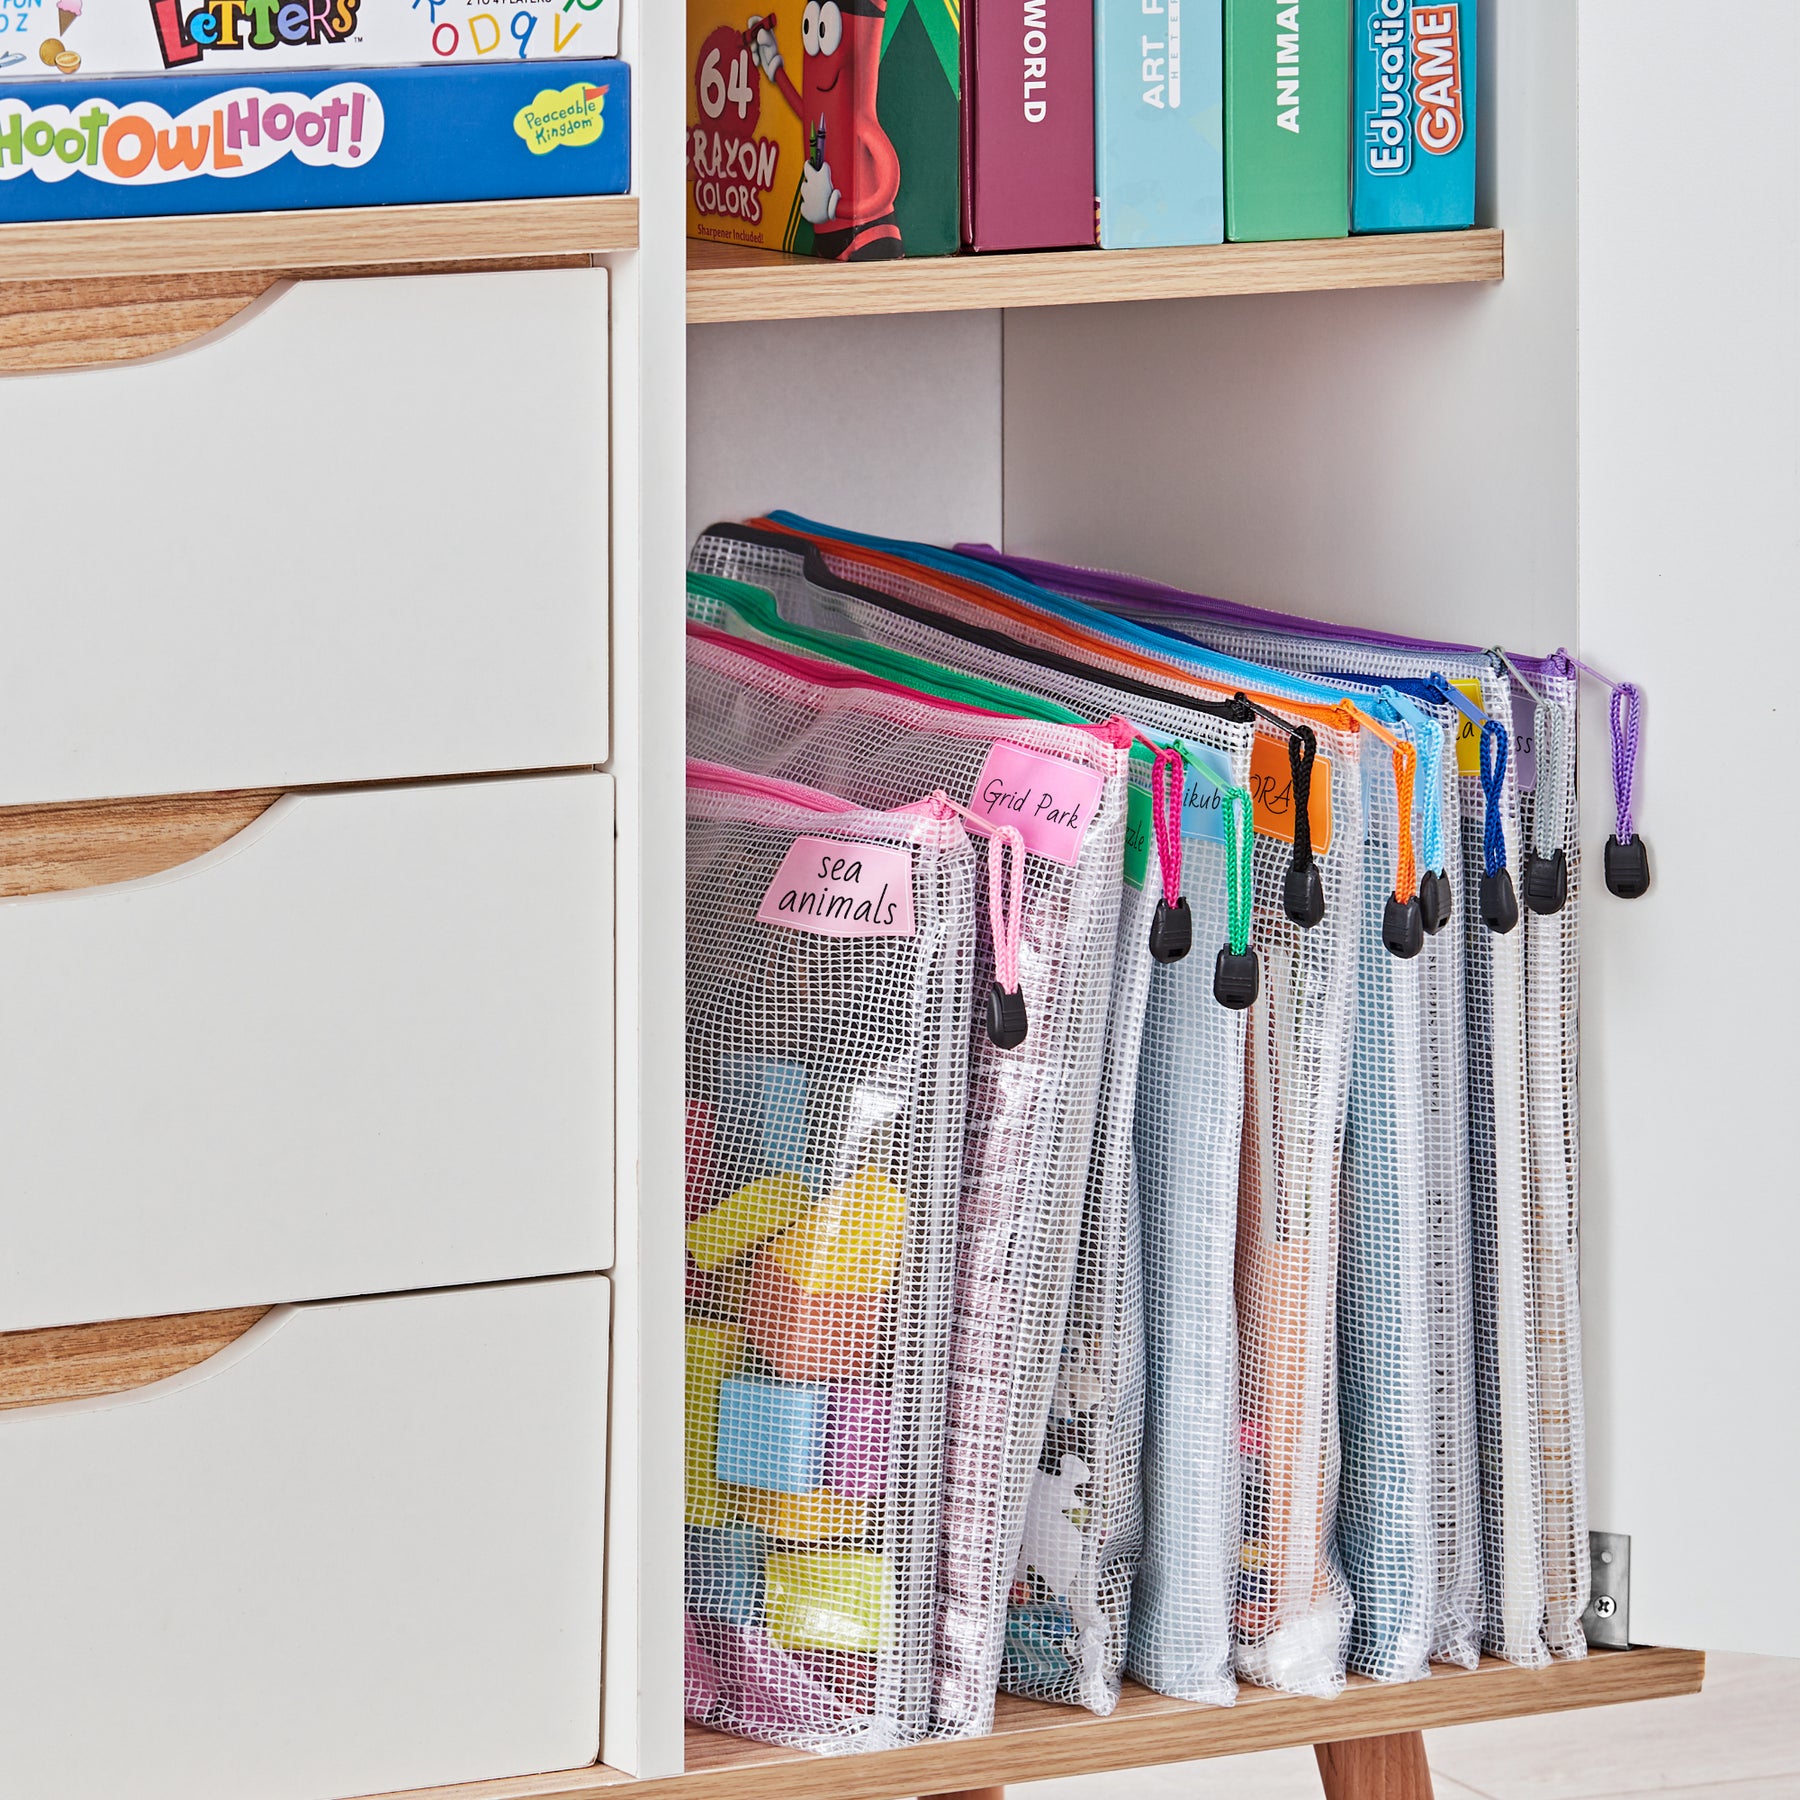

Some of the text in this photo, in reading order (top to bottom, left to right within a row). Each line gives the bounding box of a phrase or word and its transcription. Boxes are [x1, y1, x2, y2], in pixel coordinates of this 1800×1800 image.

[700, 47, 753, 119] 64
[1023, 0, 1047, 123] WORLD
[1142, 35, 1165, 109] ART
[1416, 12, 1456, 148] GAME
[524, 86, 596, 130] Peaceable
[535, 120, 592, 145] Kingdom
[686, 129, 777, 188] RAYON
[695, 179, 760, 222] COLORS
[697, 223, 765, 244] Sharpener Included!
[982, 778, 1080, 830] Grid Park
[817, 856, 862, 884] sea
[778, 883, 897, 925] animals
